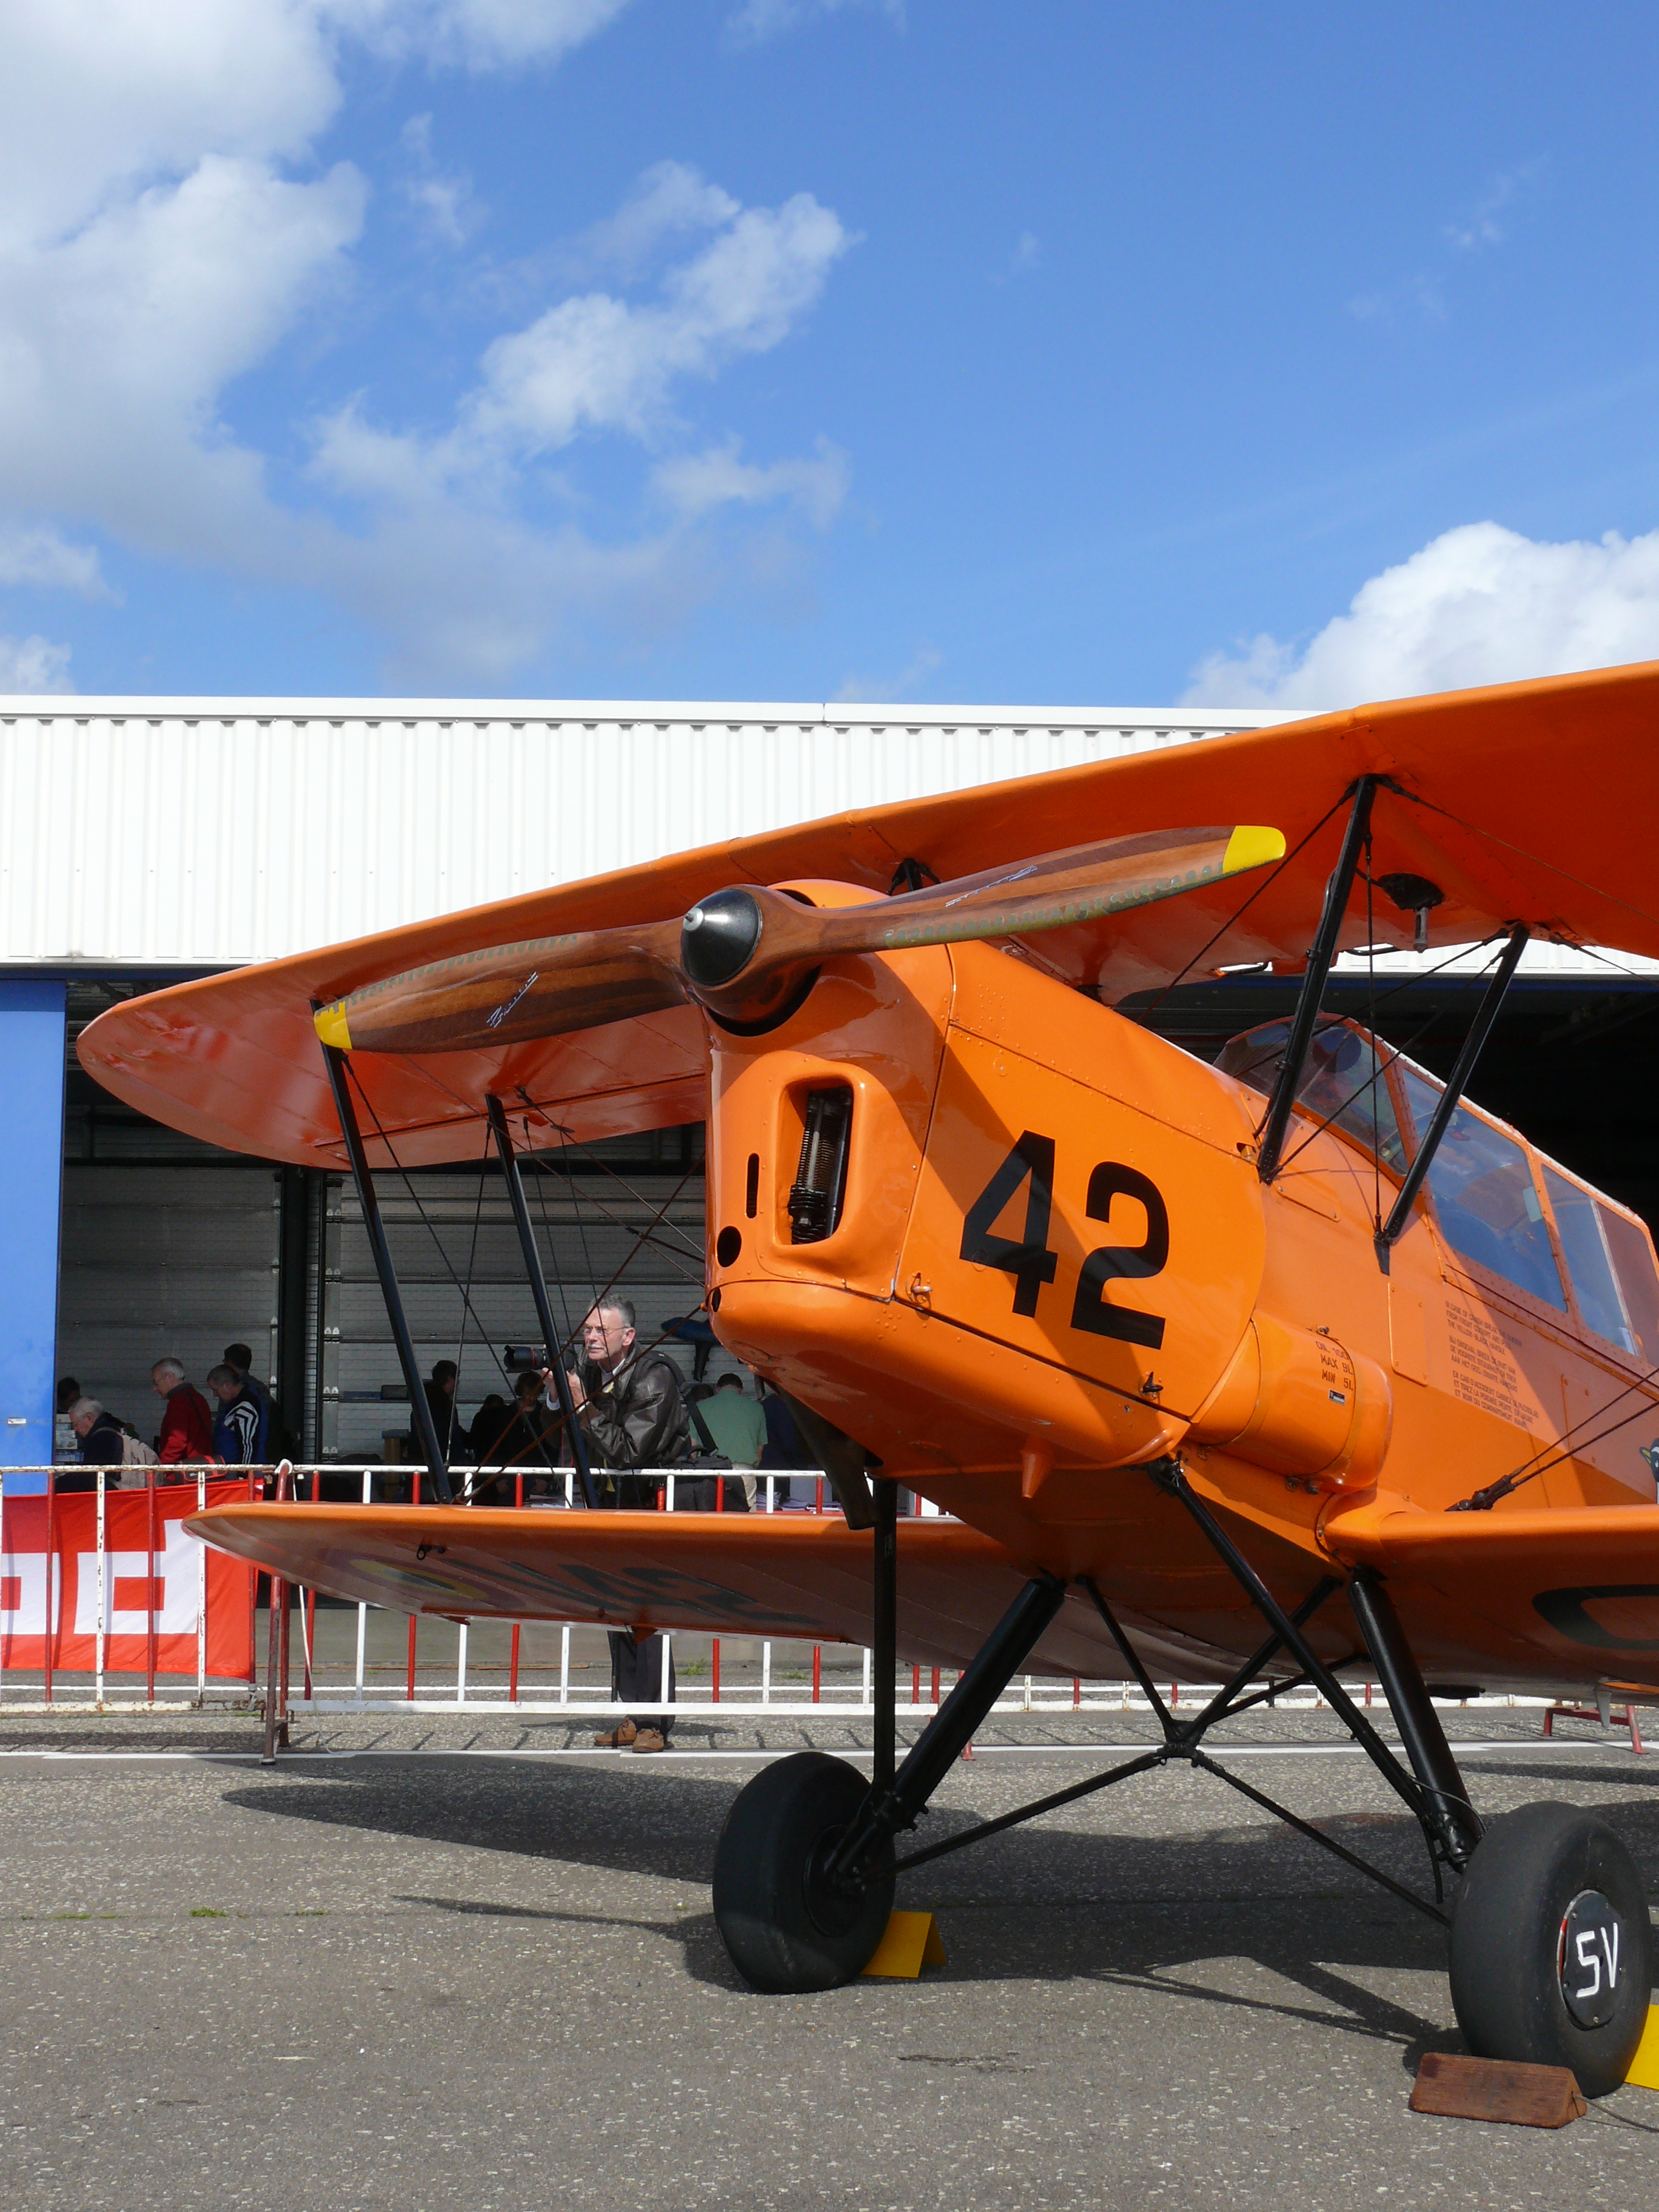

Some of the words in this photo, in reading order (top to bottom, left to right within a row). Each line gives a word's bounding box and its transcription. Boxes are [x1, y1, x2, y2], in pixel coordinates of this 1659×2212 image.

[959, 1130, 1170, 1350] 42
[1320, 1353, 1338, 1370] MAX
[1342, 1362, 1353, 1375] 9L
[1322, 1369, 1336, 1384] MIN
[1343, 1377, 1354, 1391] 5L
[1576, 1922, 1618, 1999] SV
